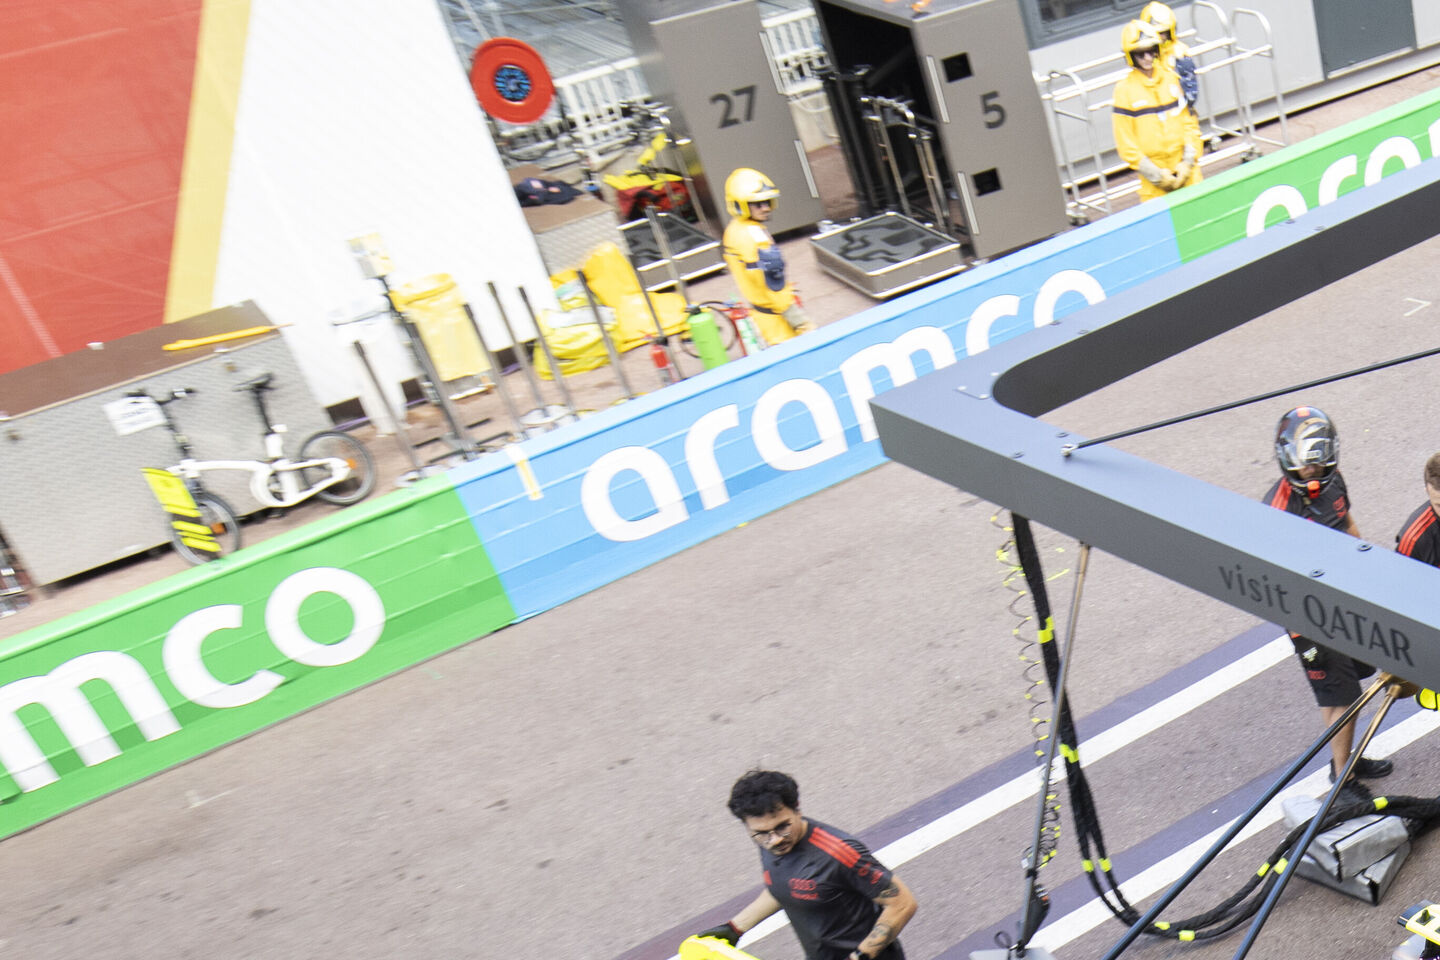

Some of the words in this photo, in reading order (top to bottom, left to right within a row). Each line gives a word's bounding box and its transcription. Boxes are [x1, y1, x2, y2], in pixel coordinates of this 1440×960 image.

[708, 86, 757, 129] 27
[981, 93, 1007, 129] 5
[1218, 564, 1291, 614] visit
[1303, 594, 1415, 667] QATAR
